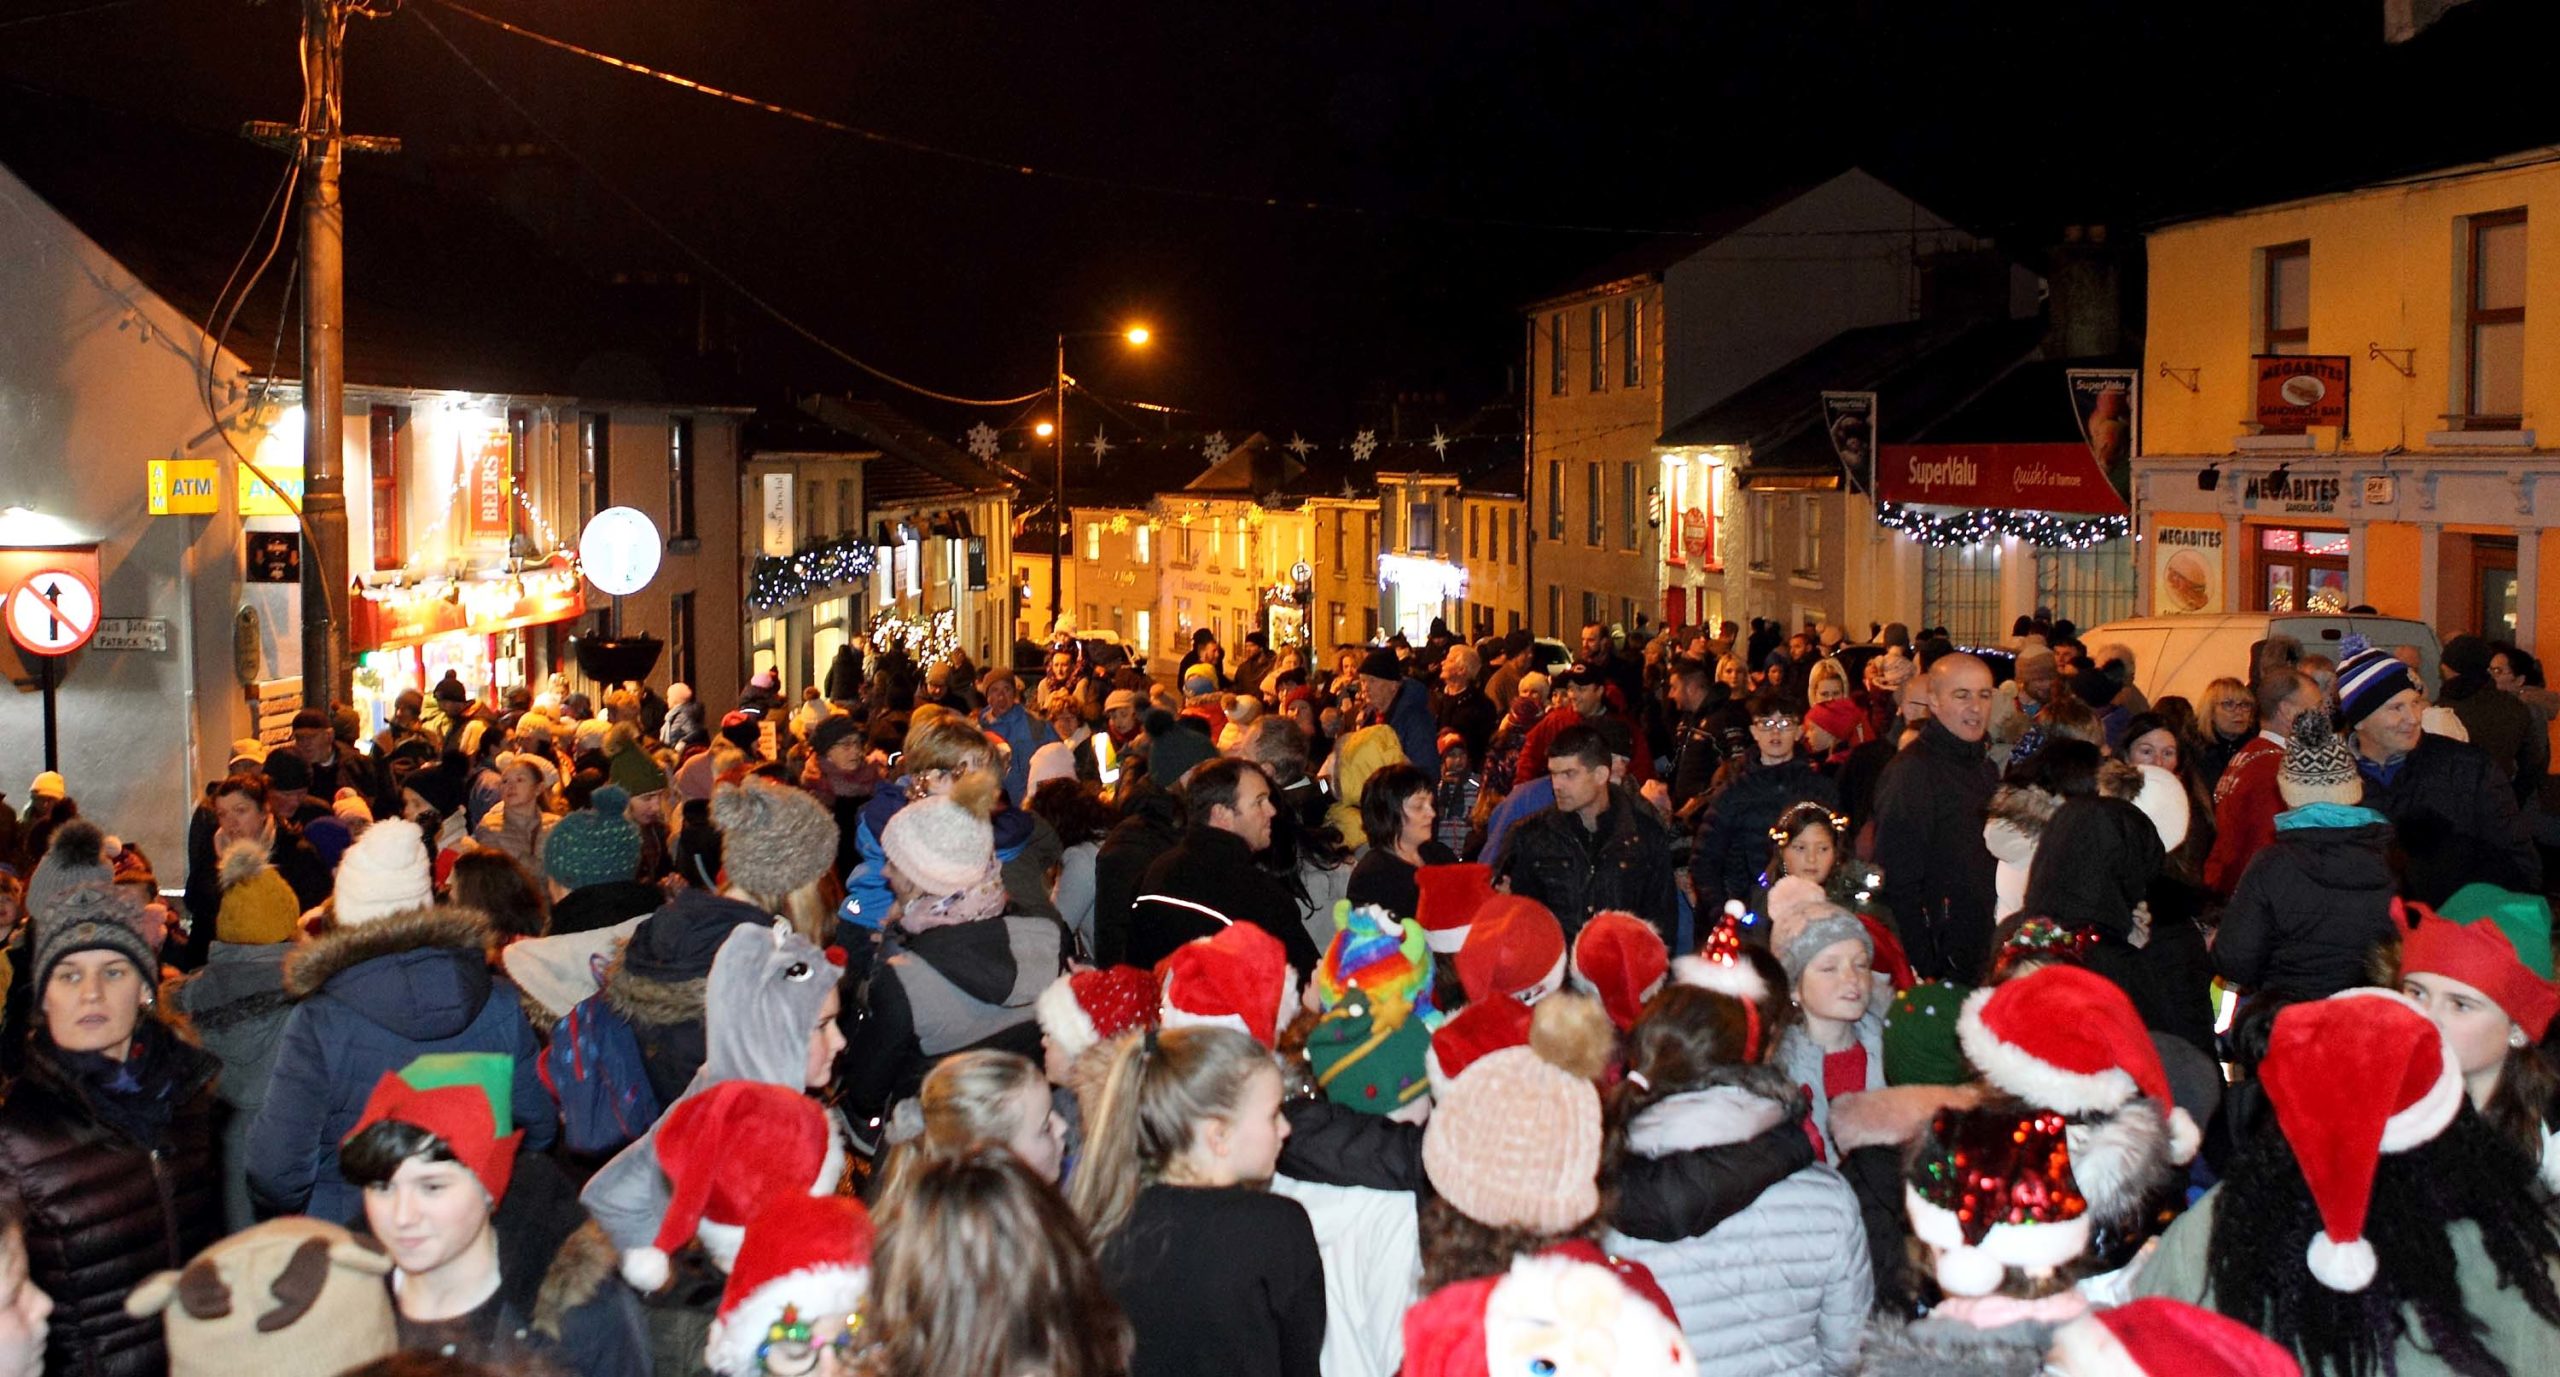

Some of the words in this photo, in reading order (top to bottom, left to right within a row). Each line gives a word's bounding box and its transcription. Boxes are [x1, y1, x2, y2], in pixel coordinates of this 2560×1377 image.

[2260, 361, 2344, 382] MEGABITES
[2076, 379, 2126, 393] SuperValu
[2260, 406, 2318, 416] SANDWICH
[2321, 406, 2342, 416] BAR
[1908, 456, 1977, 493] SuperValu
[2013, 461, 2048, 493] Quish's
[172, 478, 211, 496] ATM
[482, 455, 499, 522] BEERS
[2285, 502, 2318, 512] SANDWICH
[2158, 528, 2222, 548] MEGABITES
[101, 636, 139, 645] PATRICK
